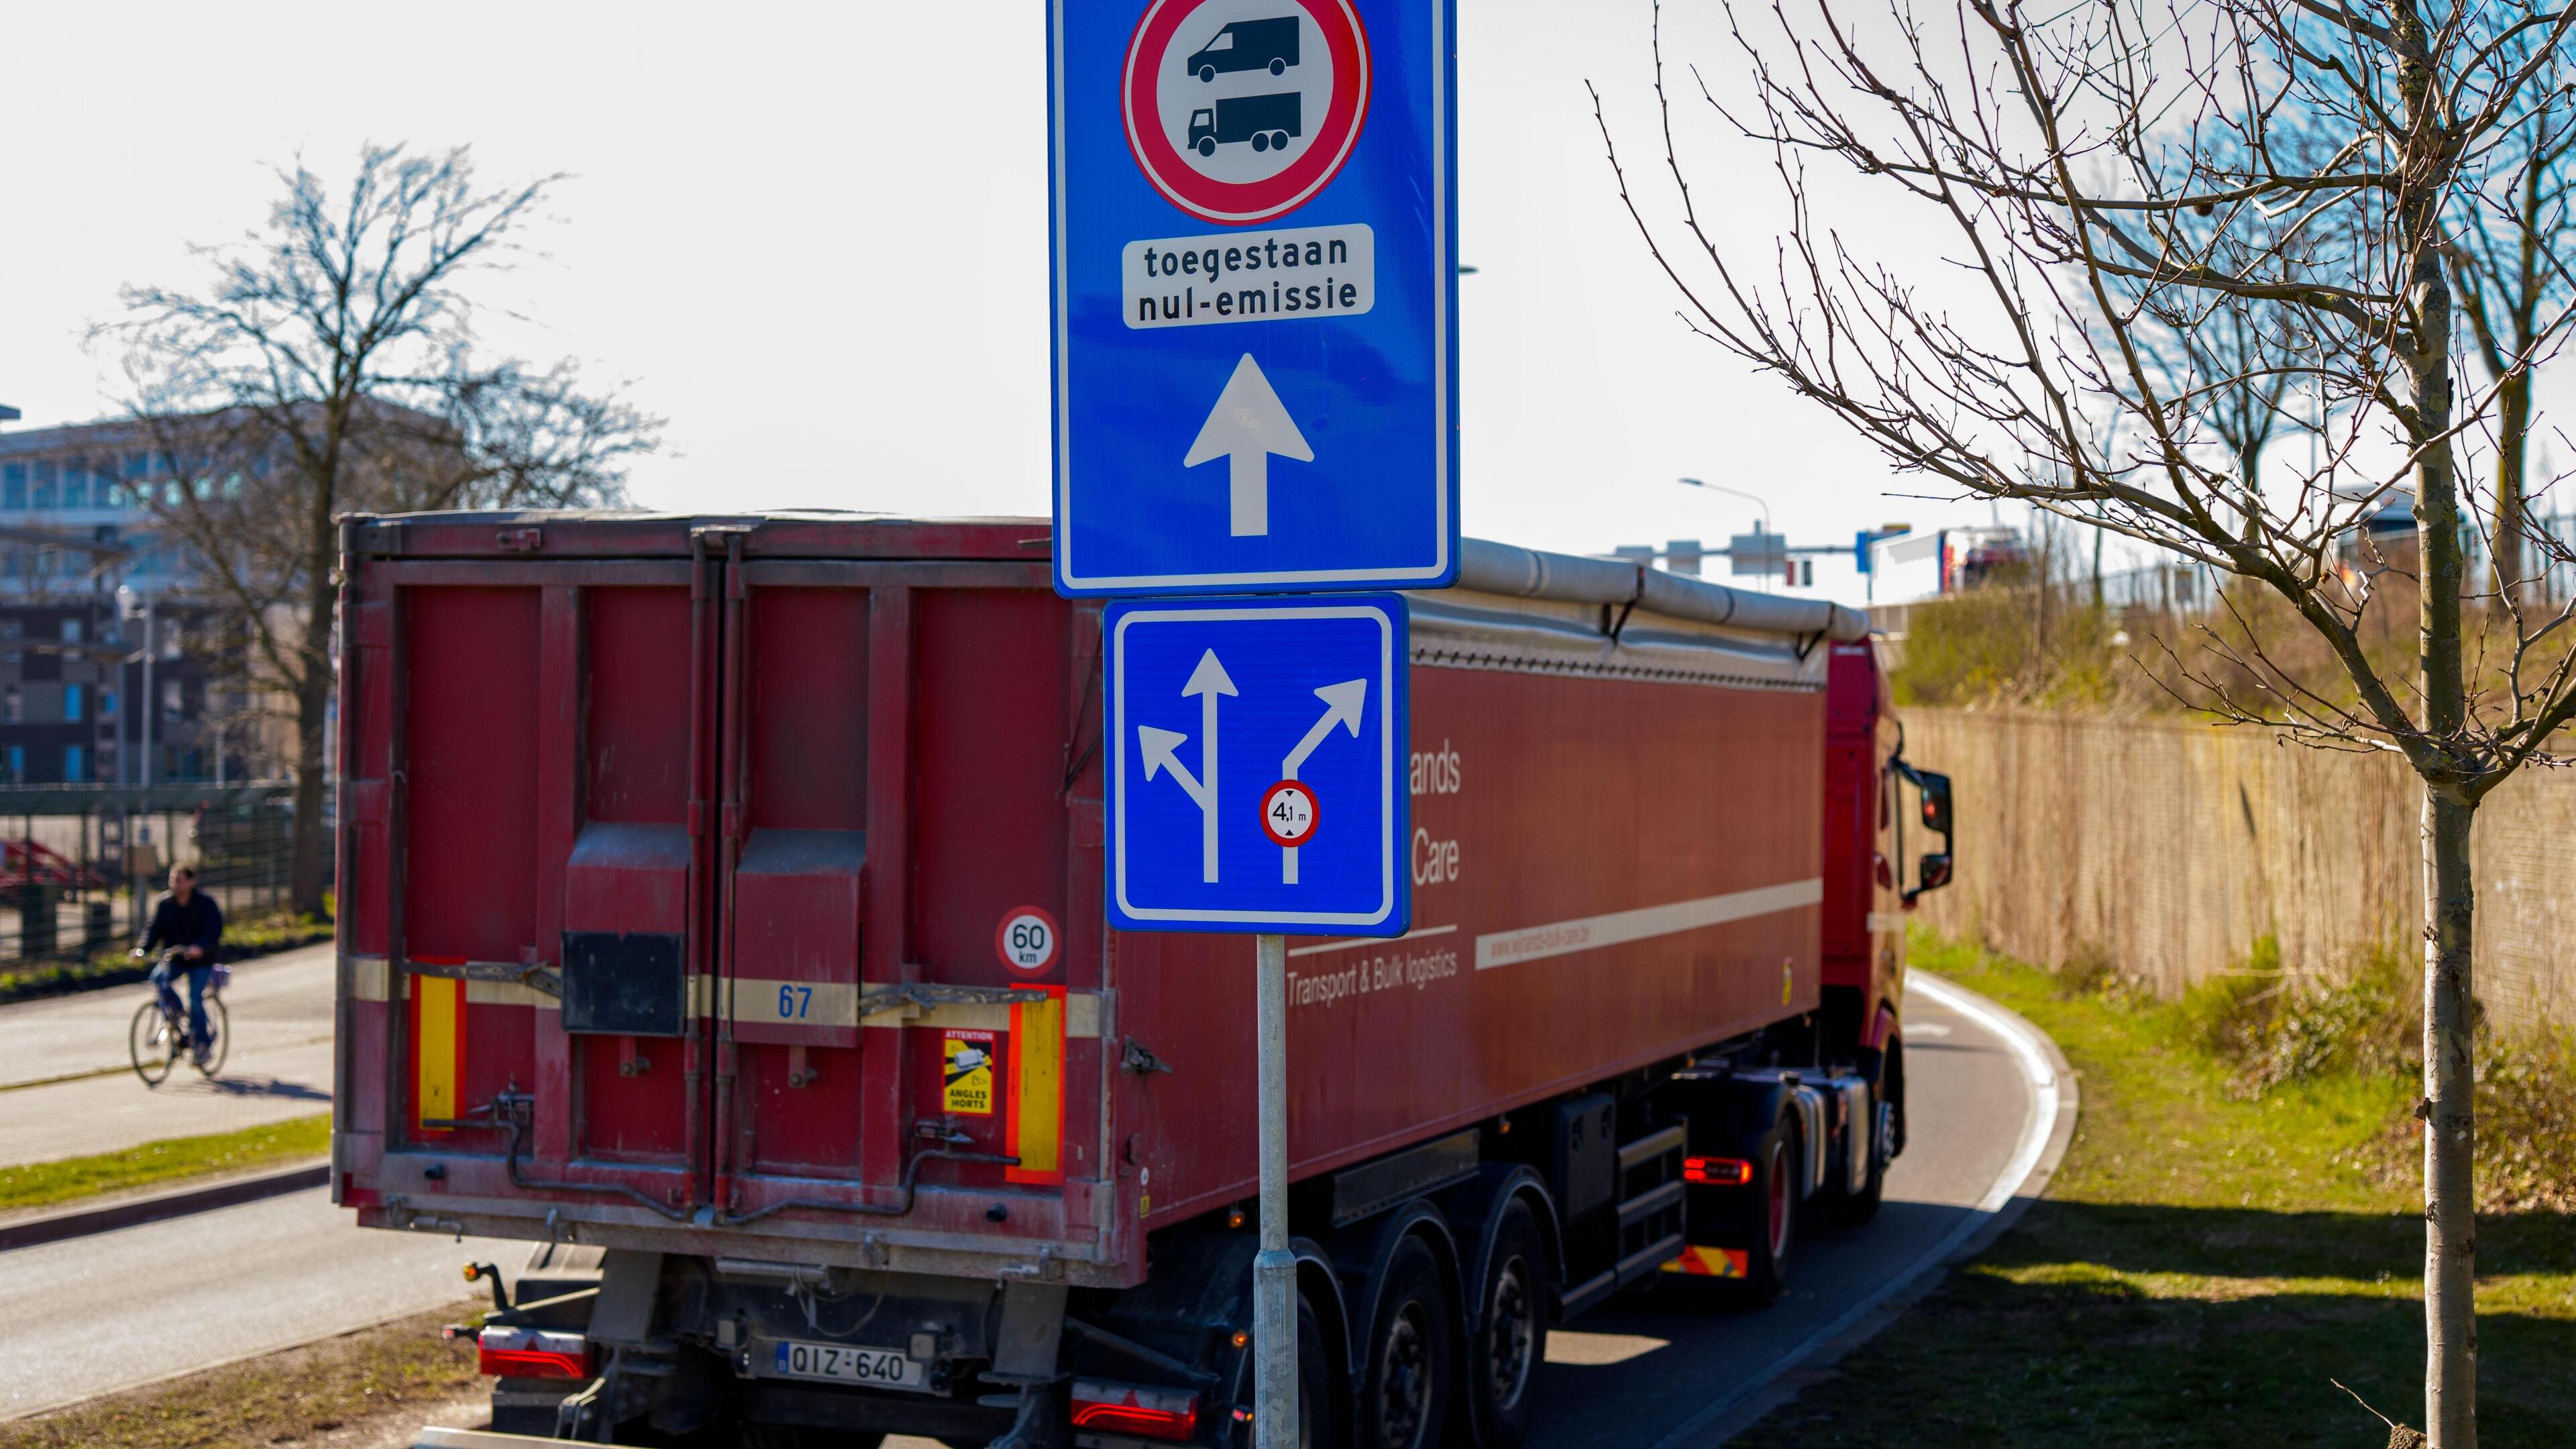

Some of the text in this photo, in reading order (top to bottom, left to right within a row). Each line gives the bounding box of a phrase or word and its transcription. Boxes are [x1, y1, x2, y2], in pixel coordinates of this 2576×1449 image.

[1144, 237, 1347, 283] toegestaan
[1140, 277, 1357, 321] nul-emissie
[1273, 802, 1293, 822] 4,1
[1411, 827, 1460, 886] Care
[1013, 924, 1044, 950] 60
[1019, 951, 1037, 963] km
[1287, 948, 1458, 1008] Transport & Bulk logistics
[780, 985, 812, 1018] 67
[945, 1030, 994, 1040] ATTENTION
[950, 1089, 987, 1099] ANGLES
[951, 1099, 985, 1109] MORTS
